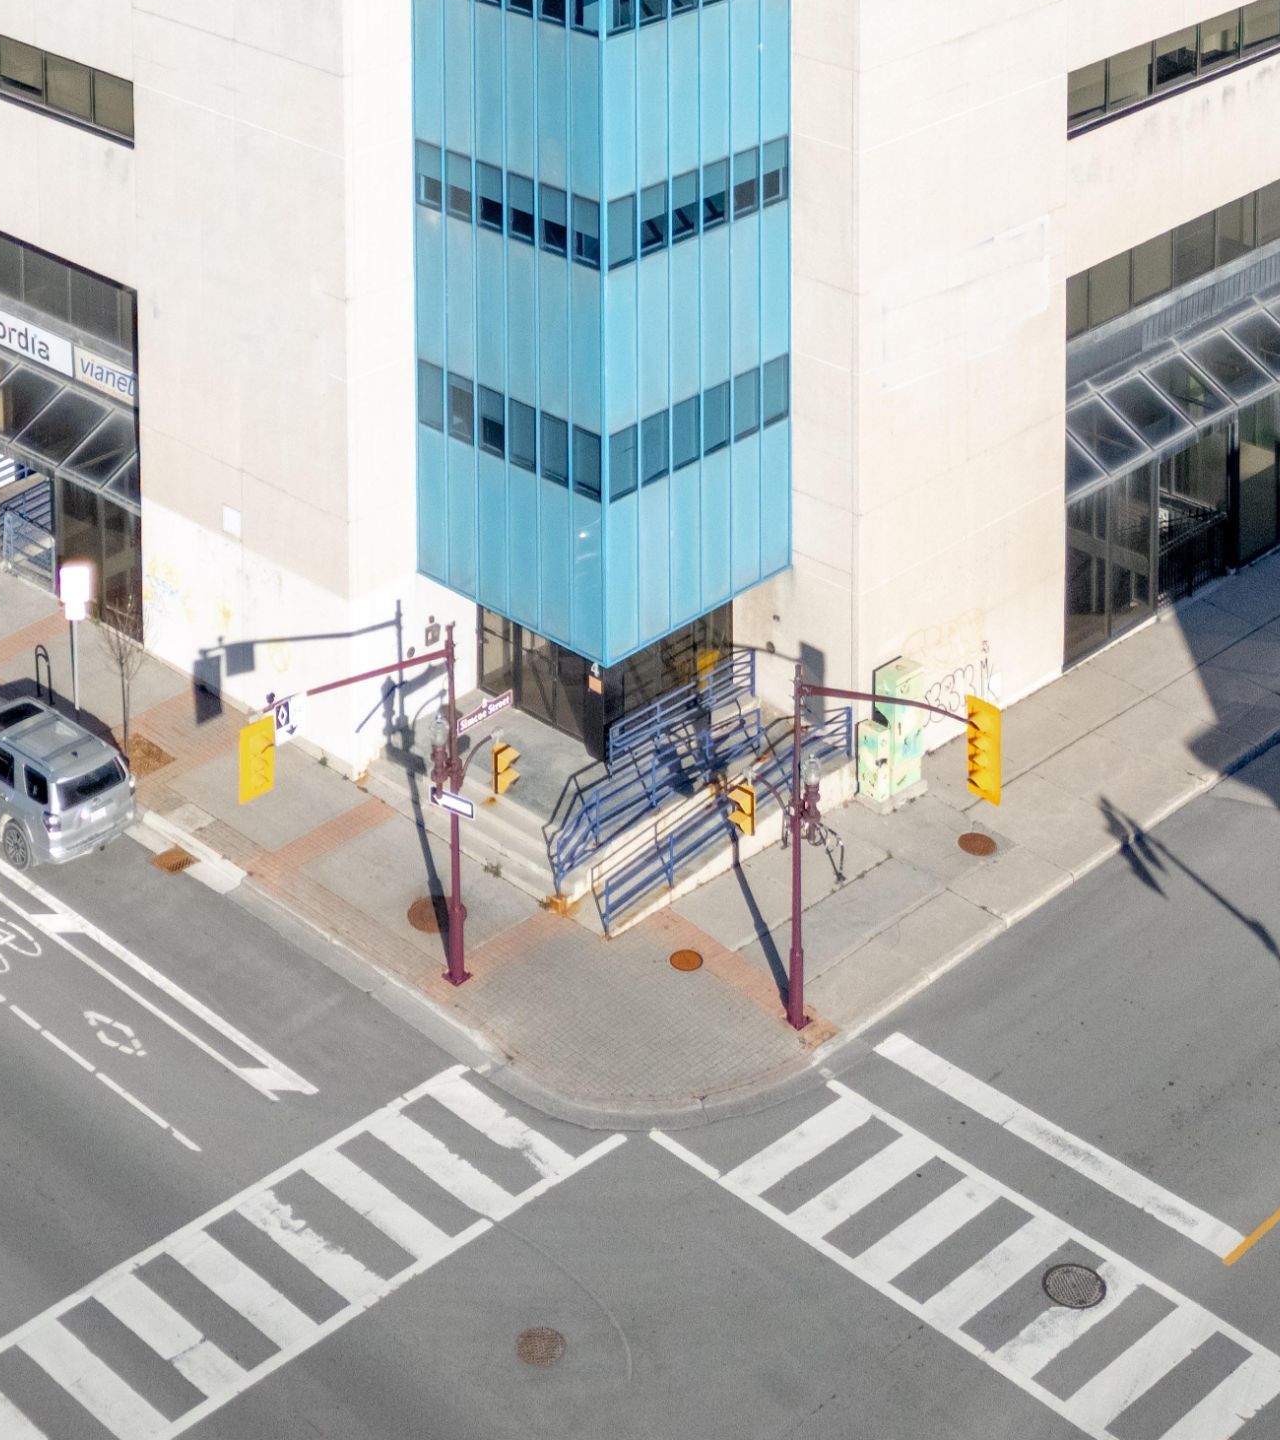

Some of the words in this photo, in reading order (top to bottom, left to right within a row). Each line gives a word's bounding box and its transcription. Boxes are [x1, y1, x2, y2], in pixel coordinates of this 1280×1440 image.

[80, 357, 137, 398] vianet
[459, 708, 487, 730] Simcoe
[488, 695, 510, 715] Street
